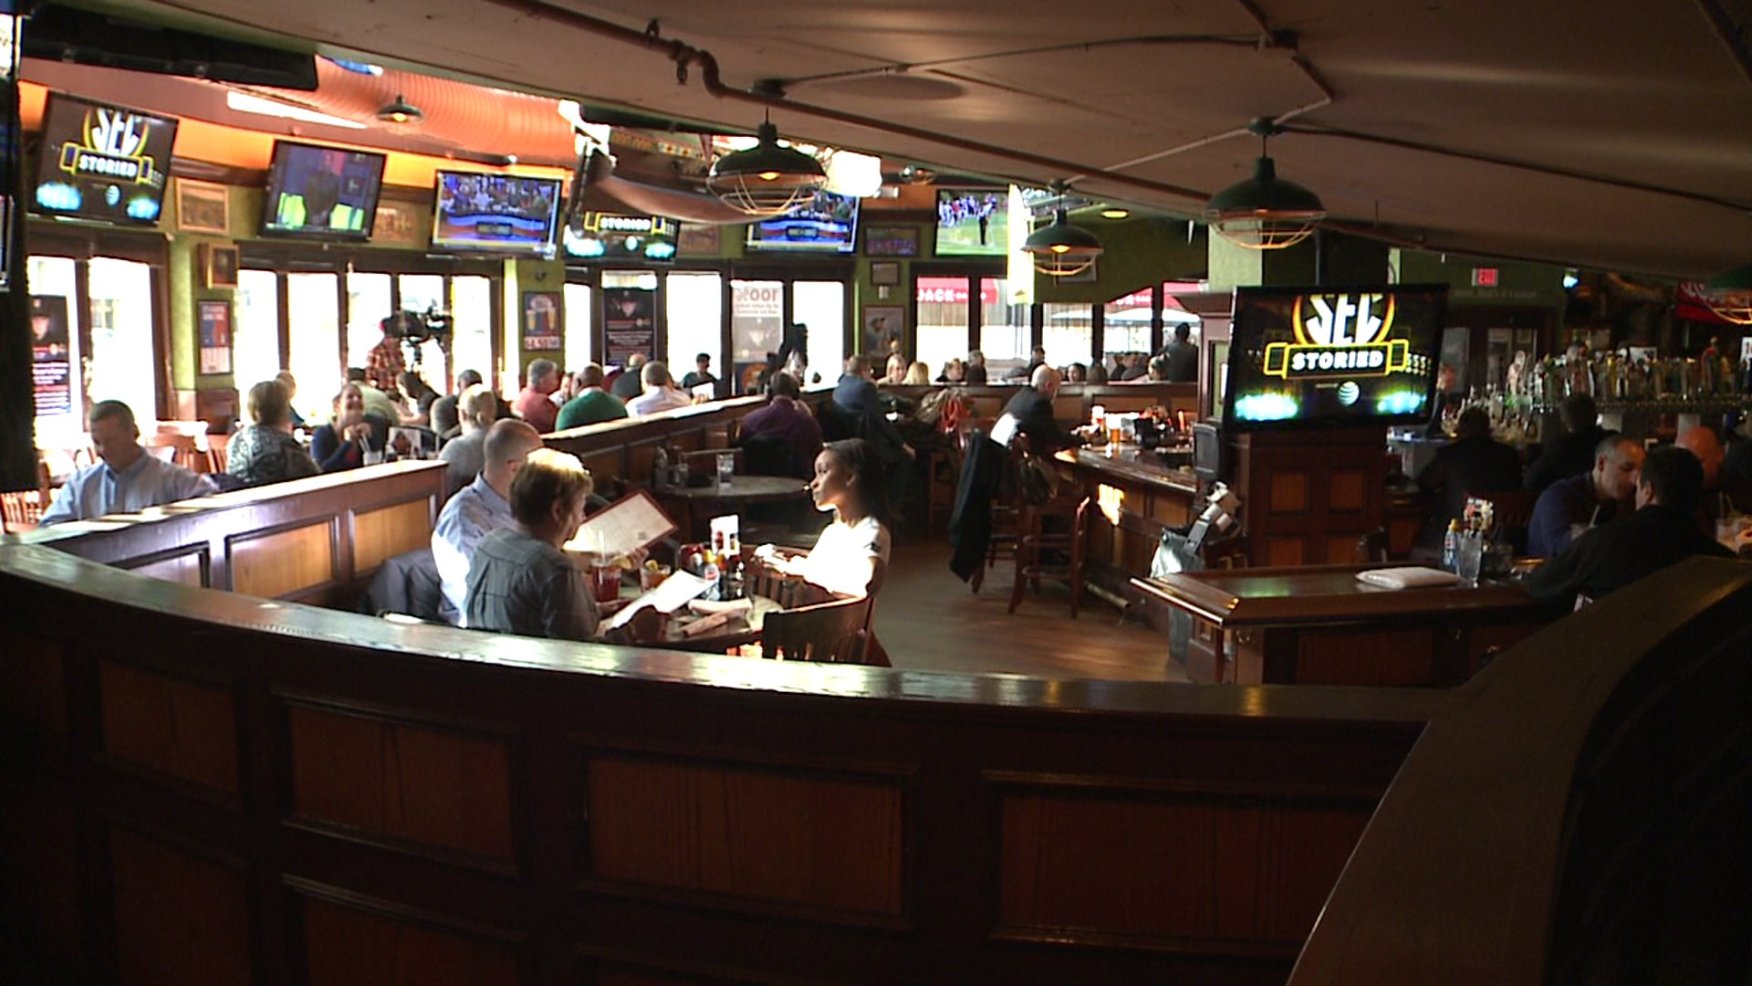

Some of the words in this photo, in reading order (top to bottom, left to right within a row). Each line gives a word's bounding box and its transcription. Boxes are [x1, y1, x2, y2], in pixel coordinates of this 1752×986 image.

[78, 154, 138, 177] STORIED
[600, 217, 651, 230] STORIED
[917, 288, 955, 302] JACK
[1292, 351, 1383, 370] STORIED
